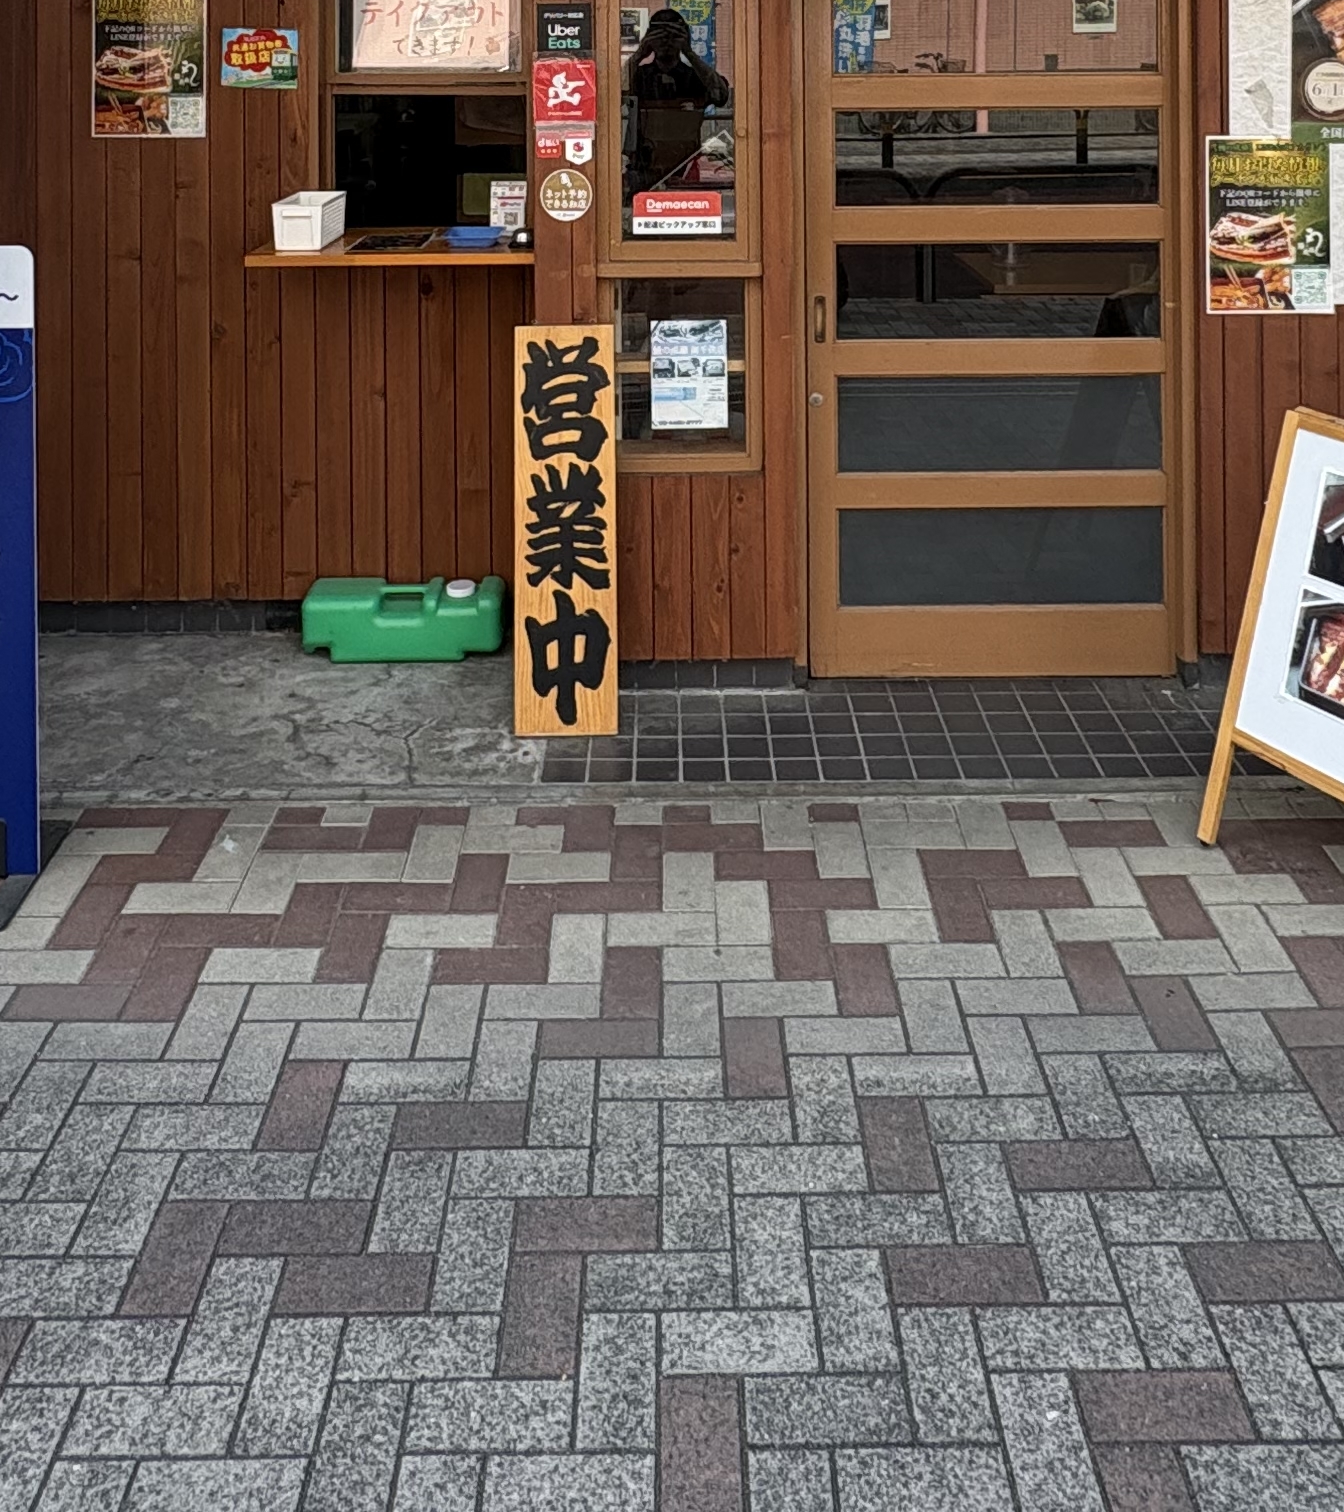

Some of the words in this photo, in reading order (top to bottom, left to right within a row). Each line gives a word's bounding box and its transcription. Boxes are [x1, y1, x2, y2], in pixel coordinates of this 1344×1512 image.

[547, 23, 581, 36] Uber
[548, 37, 581, 49] Eats
[646, 199, 710, 213] Demaecan
[521, 336, 612, 726] 営業中
